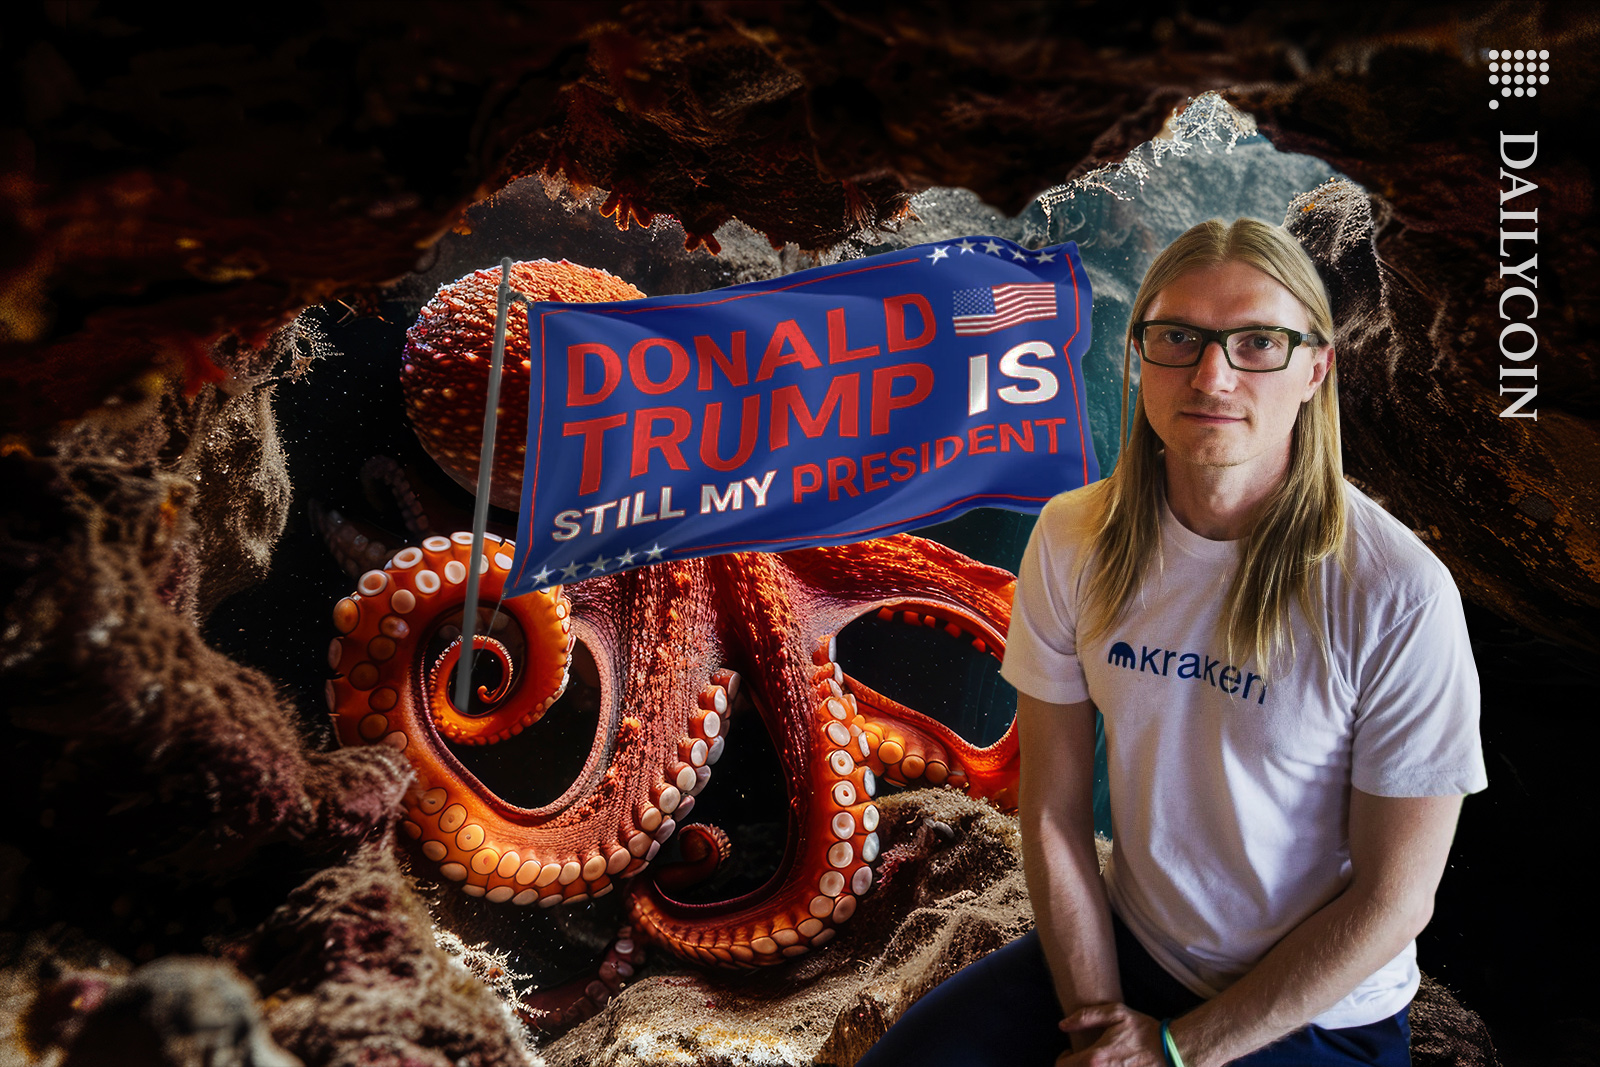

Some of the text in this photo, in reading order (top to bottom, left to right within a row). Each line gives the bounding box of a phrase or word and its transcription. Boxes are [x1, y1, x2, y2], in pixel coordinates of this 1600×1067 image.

[566, 292, 937, 407] DONALD
[562, 340, 1060, 496] TRUMP IS
[551, 417, 1067, 542] STILL MY PRESIDENT
[1140, 646, 1268, 705] kraken
